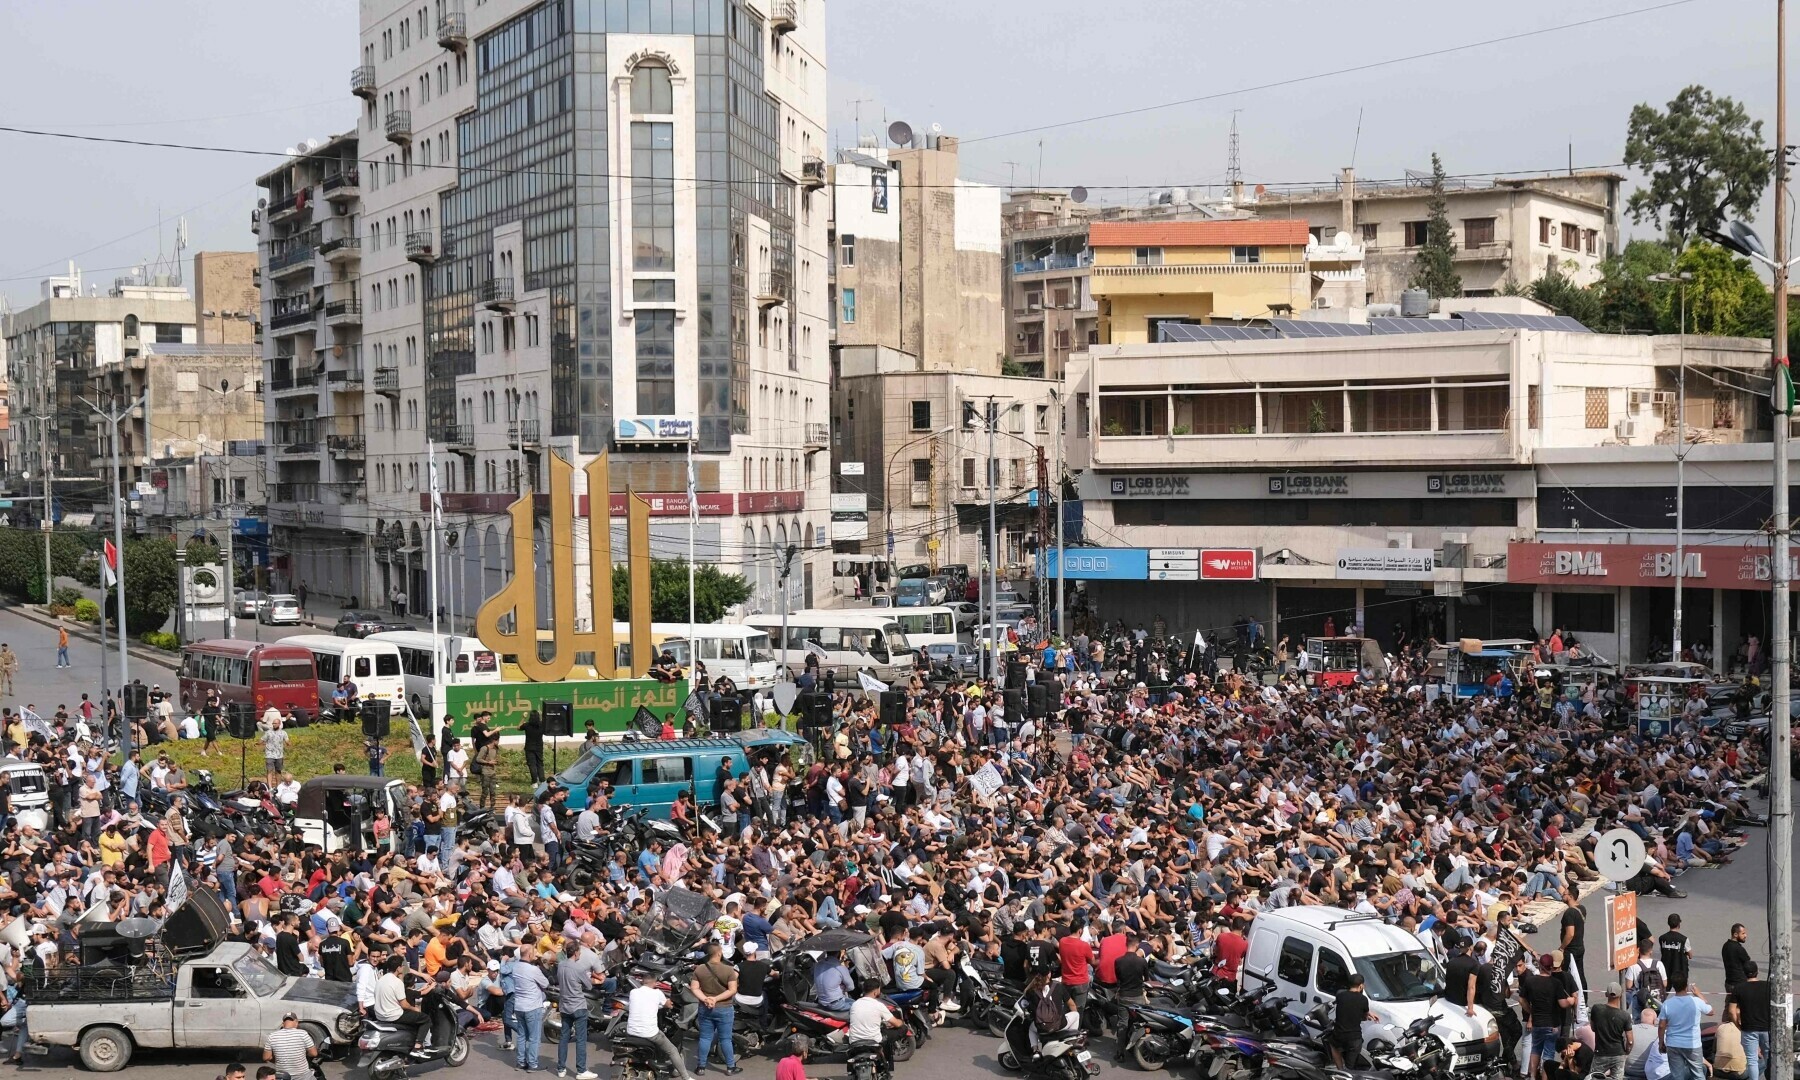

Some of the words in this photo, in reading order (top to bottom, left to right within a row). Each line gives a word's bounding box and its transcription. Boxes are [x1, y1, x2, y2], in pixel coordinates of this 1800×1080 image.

[659, 419, 692, 428] Emkan
[1128, 477, 1153, 488] LGB
[1155, 477, 1190, 489] BANK
[1286, 476, 1313, 487] LGB
[1313, 476, 1348, 487] BANK
[1445, 475, 1471, 486] LGB
[1471, 474, 1505, 486] BANK
[1642, 553, 1655, 561] بنك
[1555, 551, 1608, 576] BML
[1738, 564, 1753, 572] مصر
[1755, 554, 1800, 581] BL
[1539, 567, 1555, 575] لبنان
[1639, 569, 1655, 577] لبنان
[631, 683, 676, 708] قلعة
[461, 690, 532, 718] طرابلس
